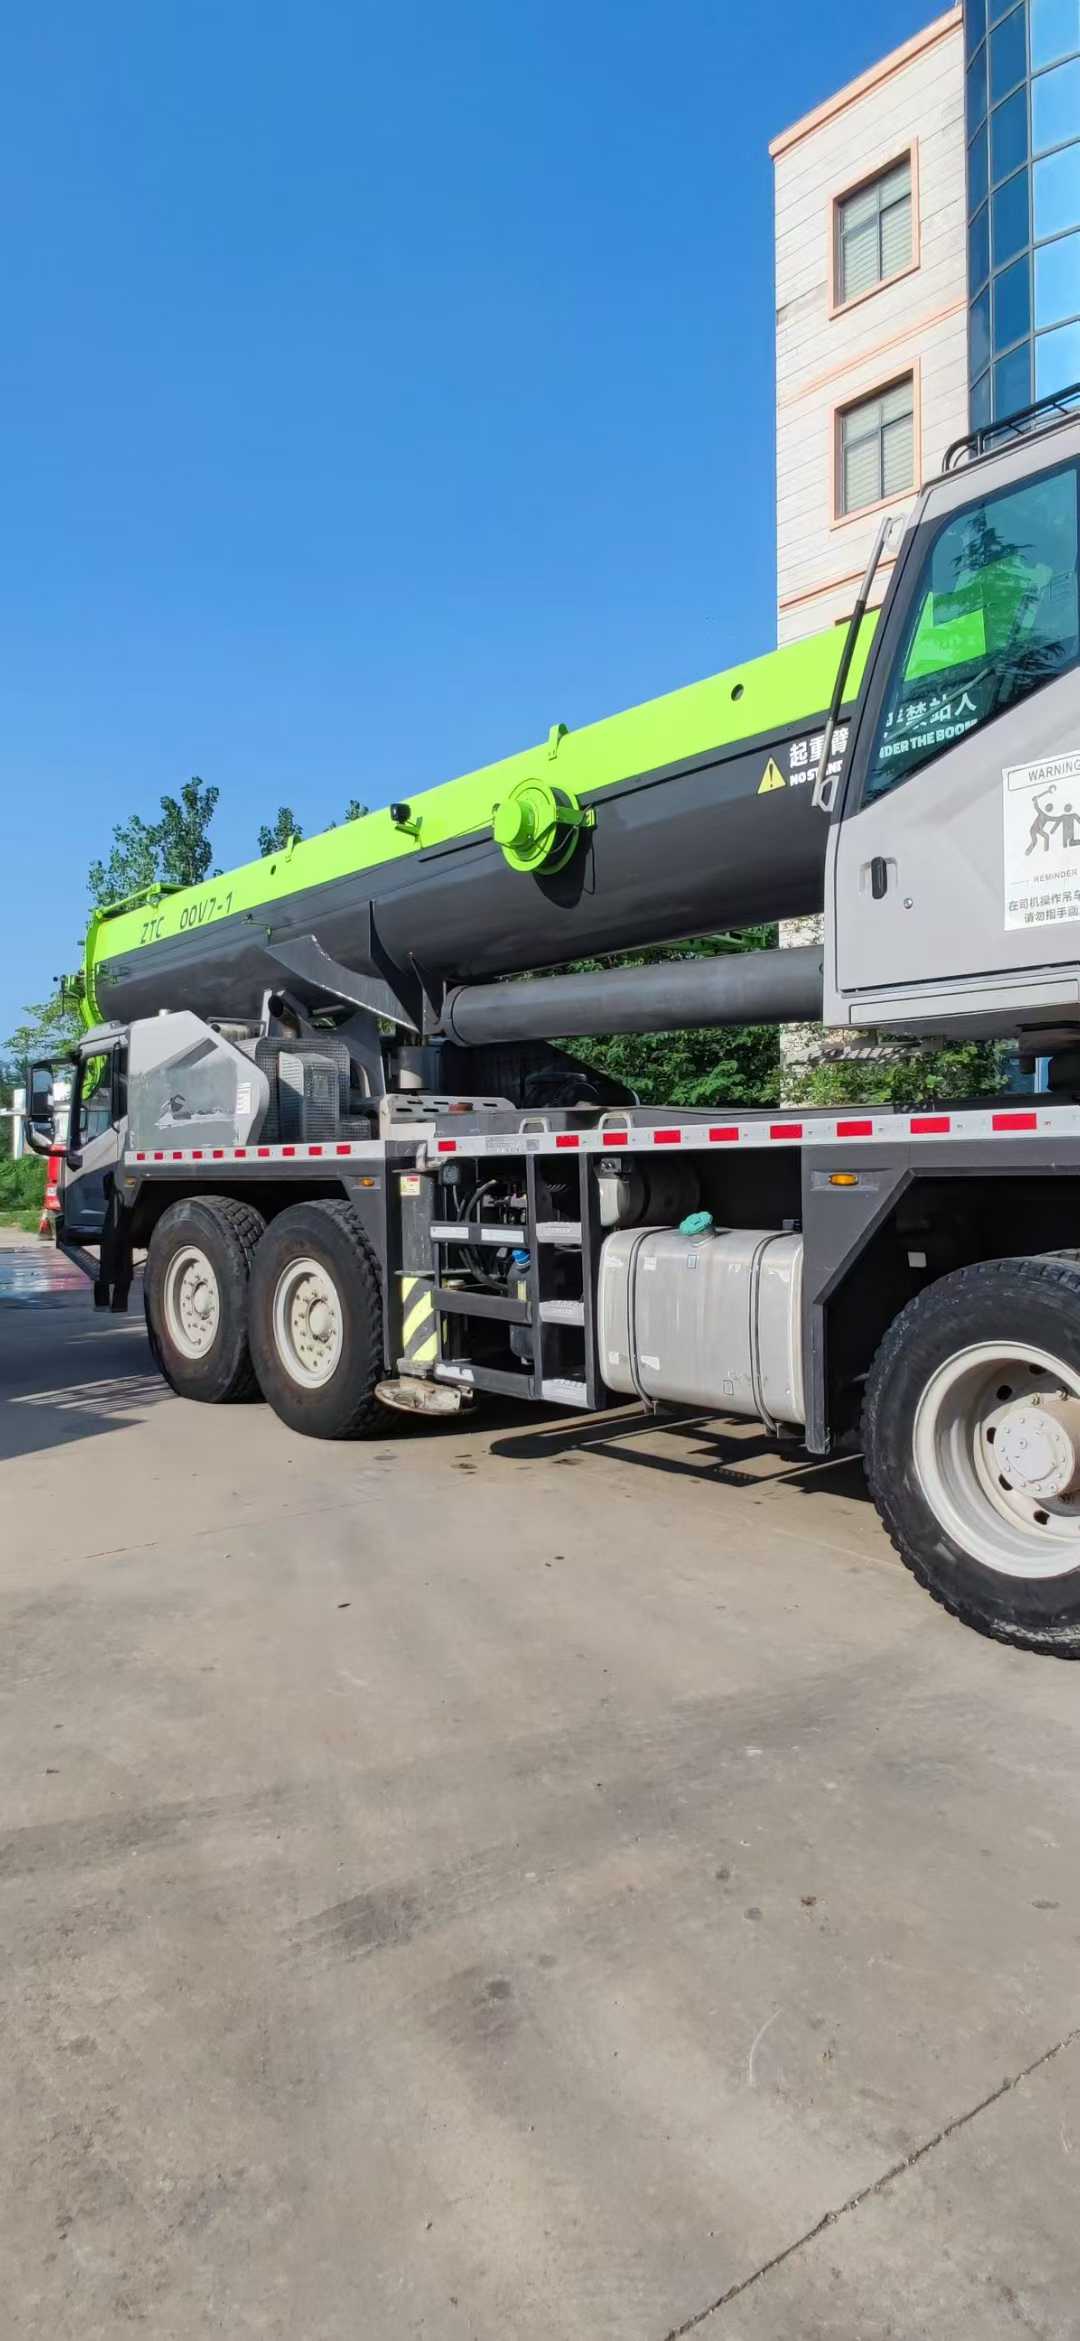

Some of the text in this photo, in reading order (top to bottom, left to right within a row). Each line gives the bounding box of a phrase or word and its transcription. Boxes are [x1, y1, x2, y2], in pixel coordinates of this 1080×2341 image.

[789, 771, 807, 787] NO
[910, 731, 935, 749] THE
[1033, 868, 1078, 882] REMINDER
[140, 915, 165, 944] ZTC
